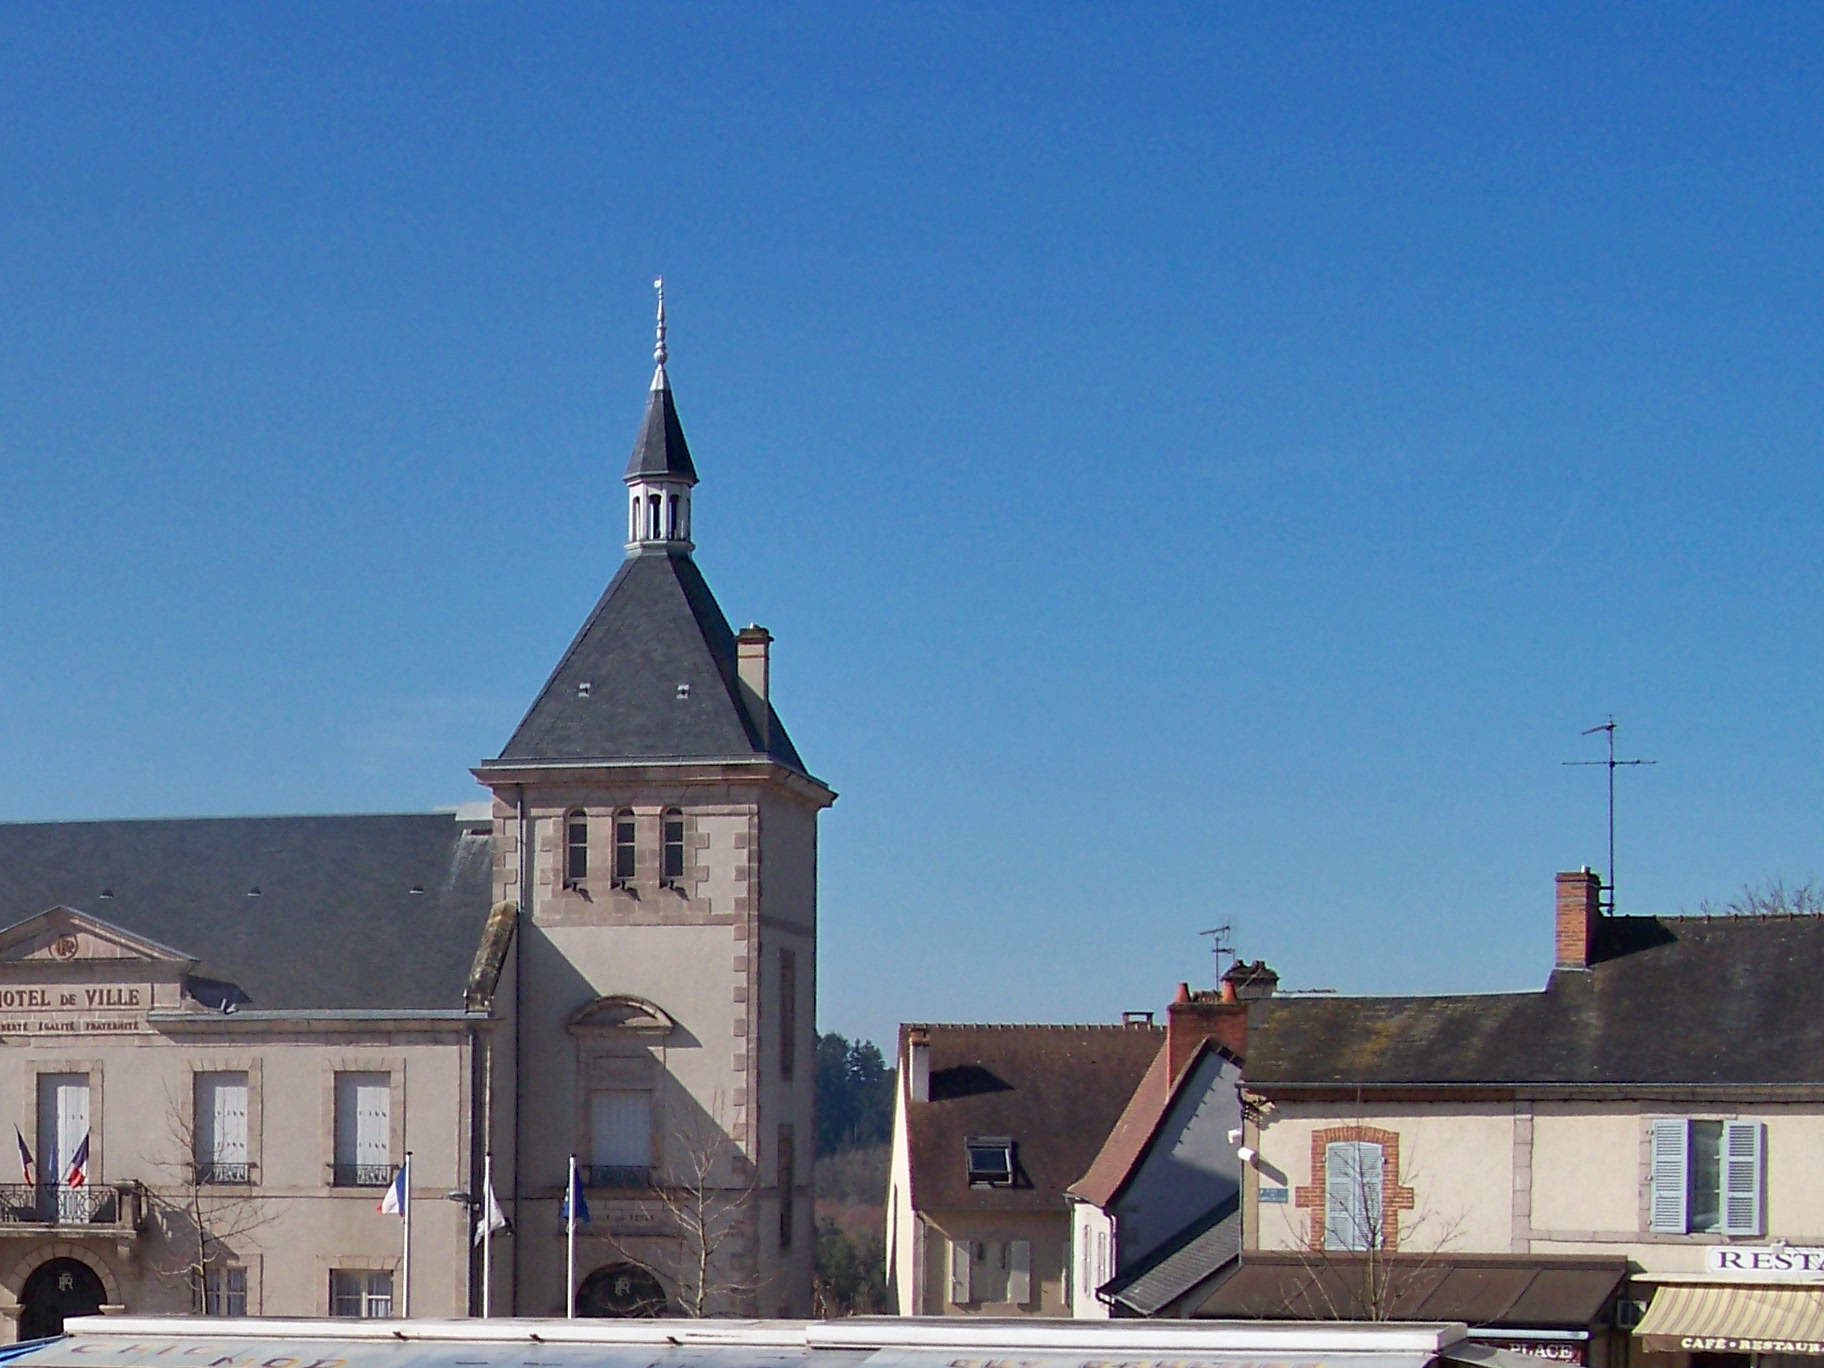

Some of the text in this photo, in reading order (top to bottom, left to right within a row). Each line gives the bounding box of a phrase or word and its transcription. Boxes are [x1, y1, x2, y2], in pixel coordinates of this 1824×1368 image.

[84, 987, 140, 1007] VILLE
[38, 1021, 75, 1031] ÉGALITÉ
[1680, 1336, 1727, 1350] CAFÉ
